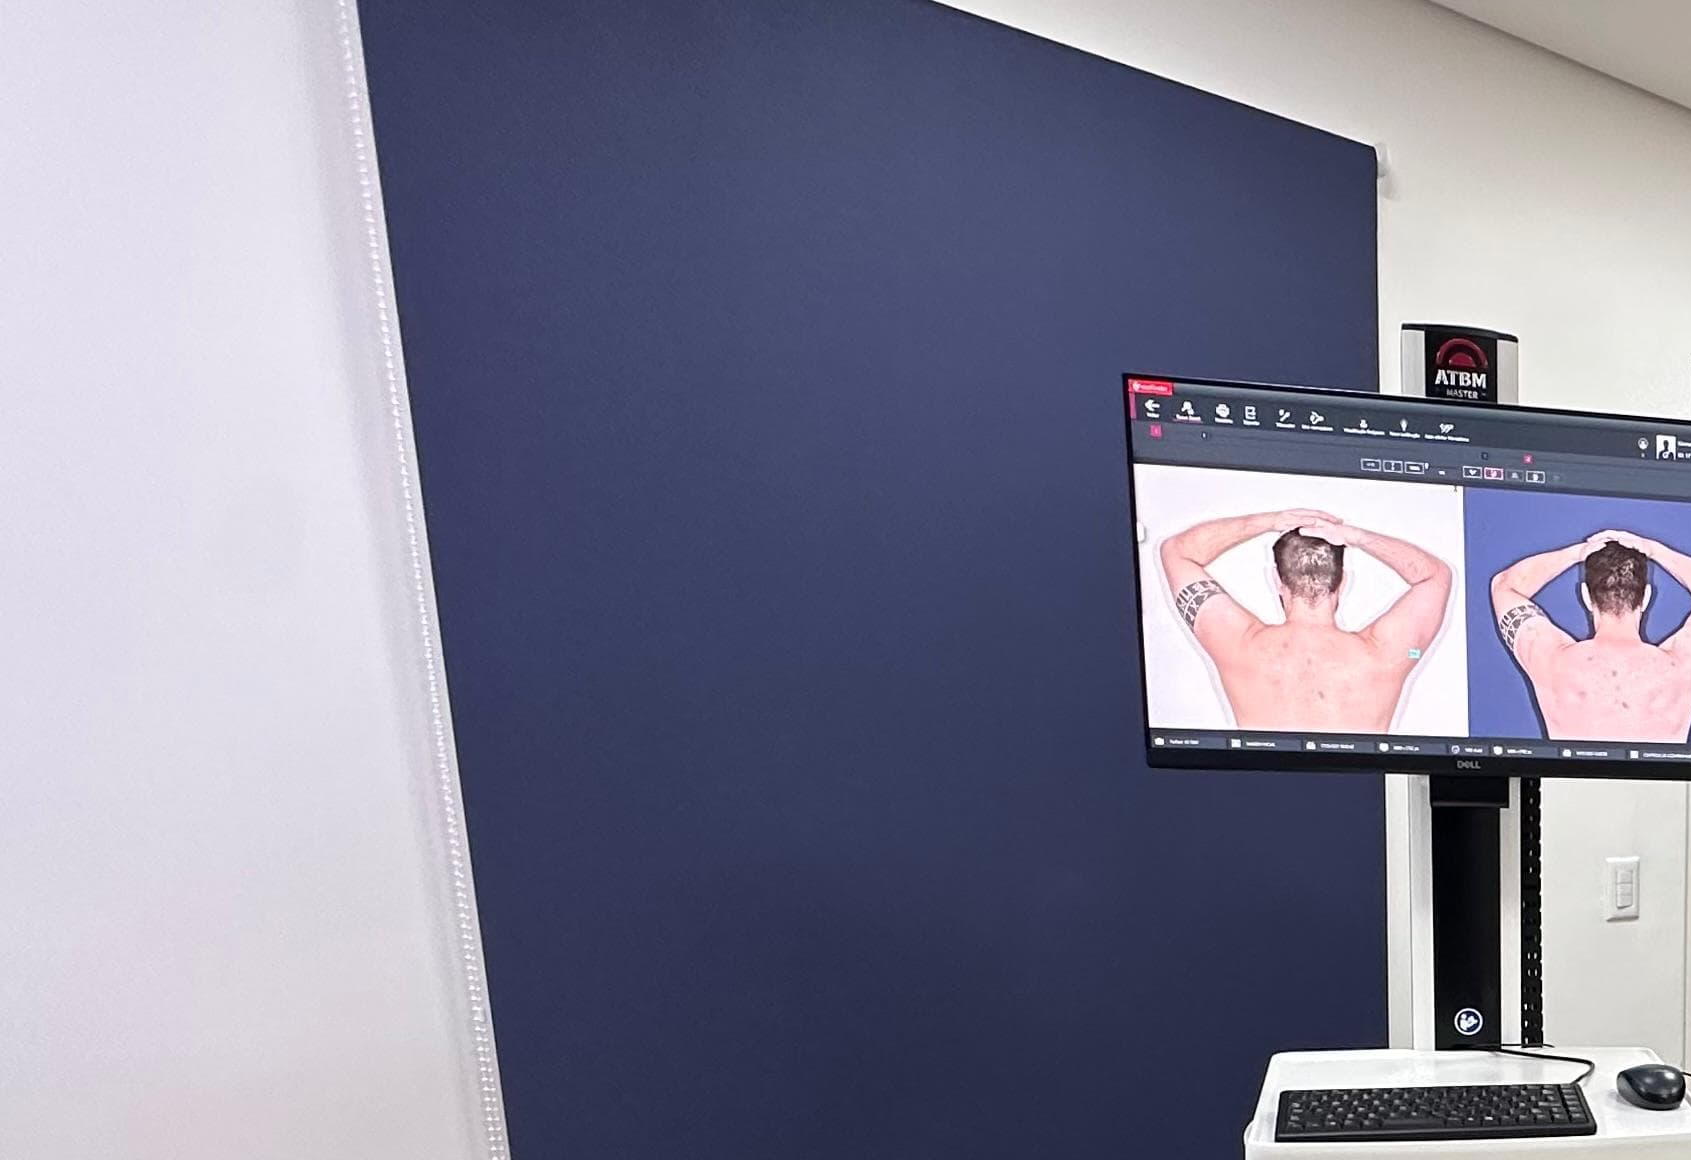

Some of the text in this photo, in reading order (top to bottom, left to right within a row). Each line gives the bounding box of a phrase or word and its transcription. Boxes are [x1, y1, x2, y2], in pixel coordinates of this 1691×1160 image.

[1434, 369, 1487, 389] ATBM
[1446, 388, 1479, 400] MASTER
[1456, 759, 1481, 769] DELL
